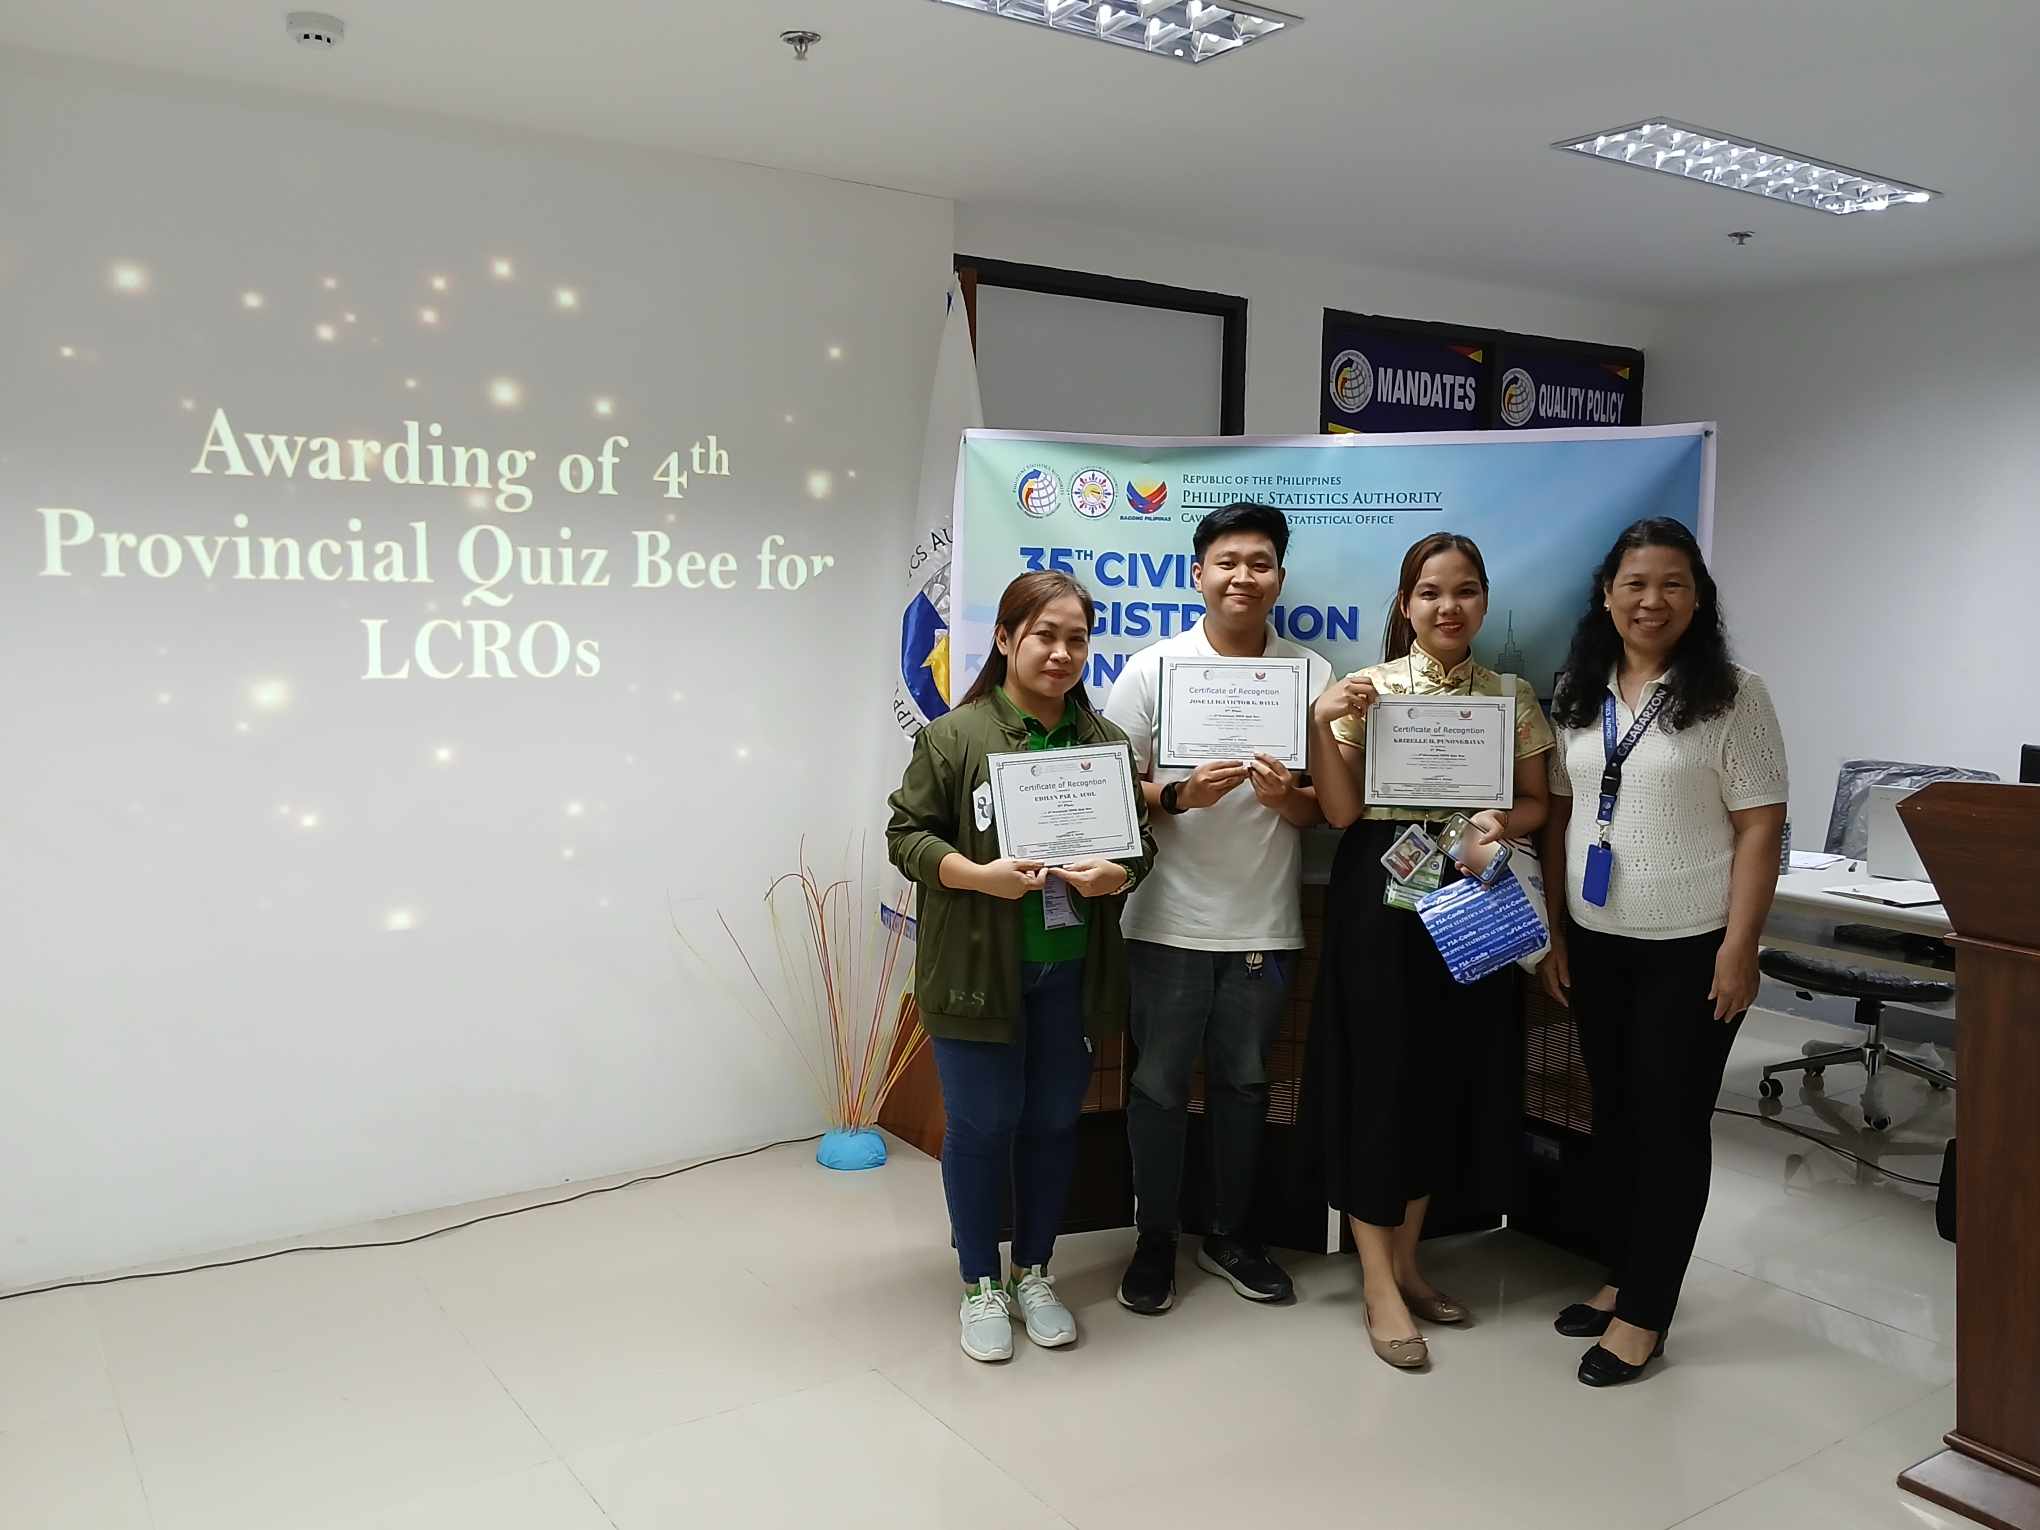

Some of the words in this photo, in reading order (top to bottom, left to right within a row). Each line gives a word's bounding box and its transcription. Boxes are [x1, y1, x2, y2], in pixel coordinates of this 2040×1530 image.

[1377, 366, 1477, 412] MANDATES
[1538, 382, 1586, 421] QUALITY
[1587, 390, 1625, 425] POLICY
[191, 406, 536, 513] Awarding
[558, 435, 630, 496] of
[653, 436, 732, 501] 4th
[1182, 474, 1232, 485] REPUBLIC
[1235, 475, 1249, 485] OF
[1252, 475, 1273, 486] THE
[1276, 475, 1342, 487] PHILIPPINES
[1182, 489, 1264, 504] PHILIPPINE
[1268, 490, 1349, 505] STATISTICS
[1353, 491, 1443, 505] AUTHORITY
[1287, 514, 1353, 526] STATISTICAL
[1355, 514, 1395, 526] OFFICE
[38, 506, 434, 584] Provincial
[457, 523, 612, 607] Quiz
[632, 529, 739, 590] Bee
[757, 533, 835, 592] for
[360, 617, 602, 681] LCROs
[1189, 687, 1226, 695] Certificate
[1229, 687, 1237, 695] of
[1617, 688, 1667, 757] CALABARZON
[1019, 782, 1057, 792] Certificate
[1058, 781, 1066, 789] of
